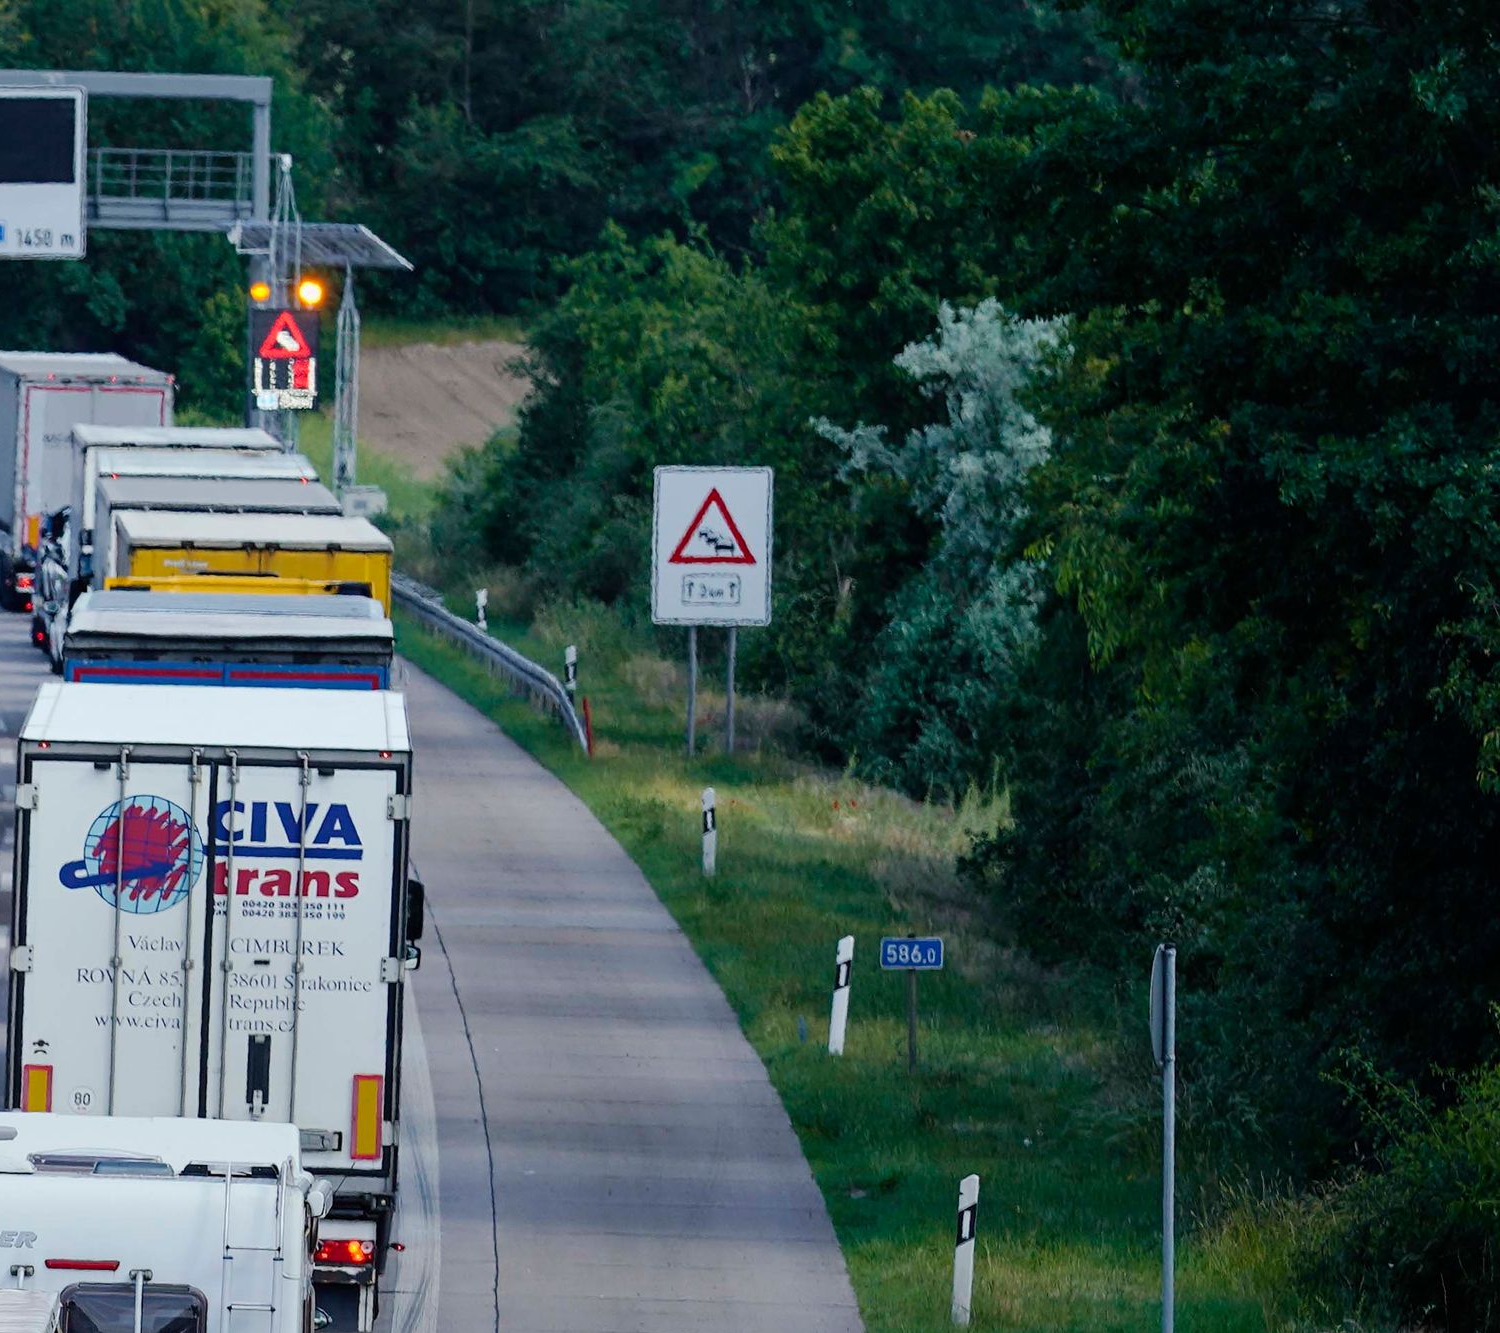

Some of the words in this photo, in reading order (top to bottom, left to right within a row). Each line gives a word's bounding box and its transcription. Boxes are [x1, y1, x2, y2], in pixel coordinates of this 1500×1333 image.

[213, 801, 363, 846] CIVA
[213, 862, 360, 899] trans
[242, 900, 275, 909] 00420
[242, 910, 275, 918] 00420
[128, 935, 184, 951] Václav
[230, 938, 345, 957] CIMBUREK
[77, 967, 152, 985] ROVNÁ
[229, 973, 277, 989] 38601
[284, 974, 372, 993] Srakonice
[128, 991, 182, 1008] Czech
[74, 1091, 91, 1105] 80
